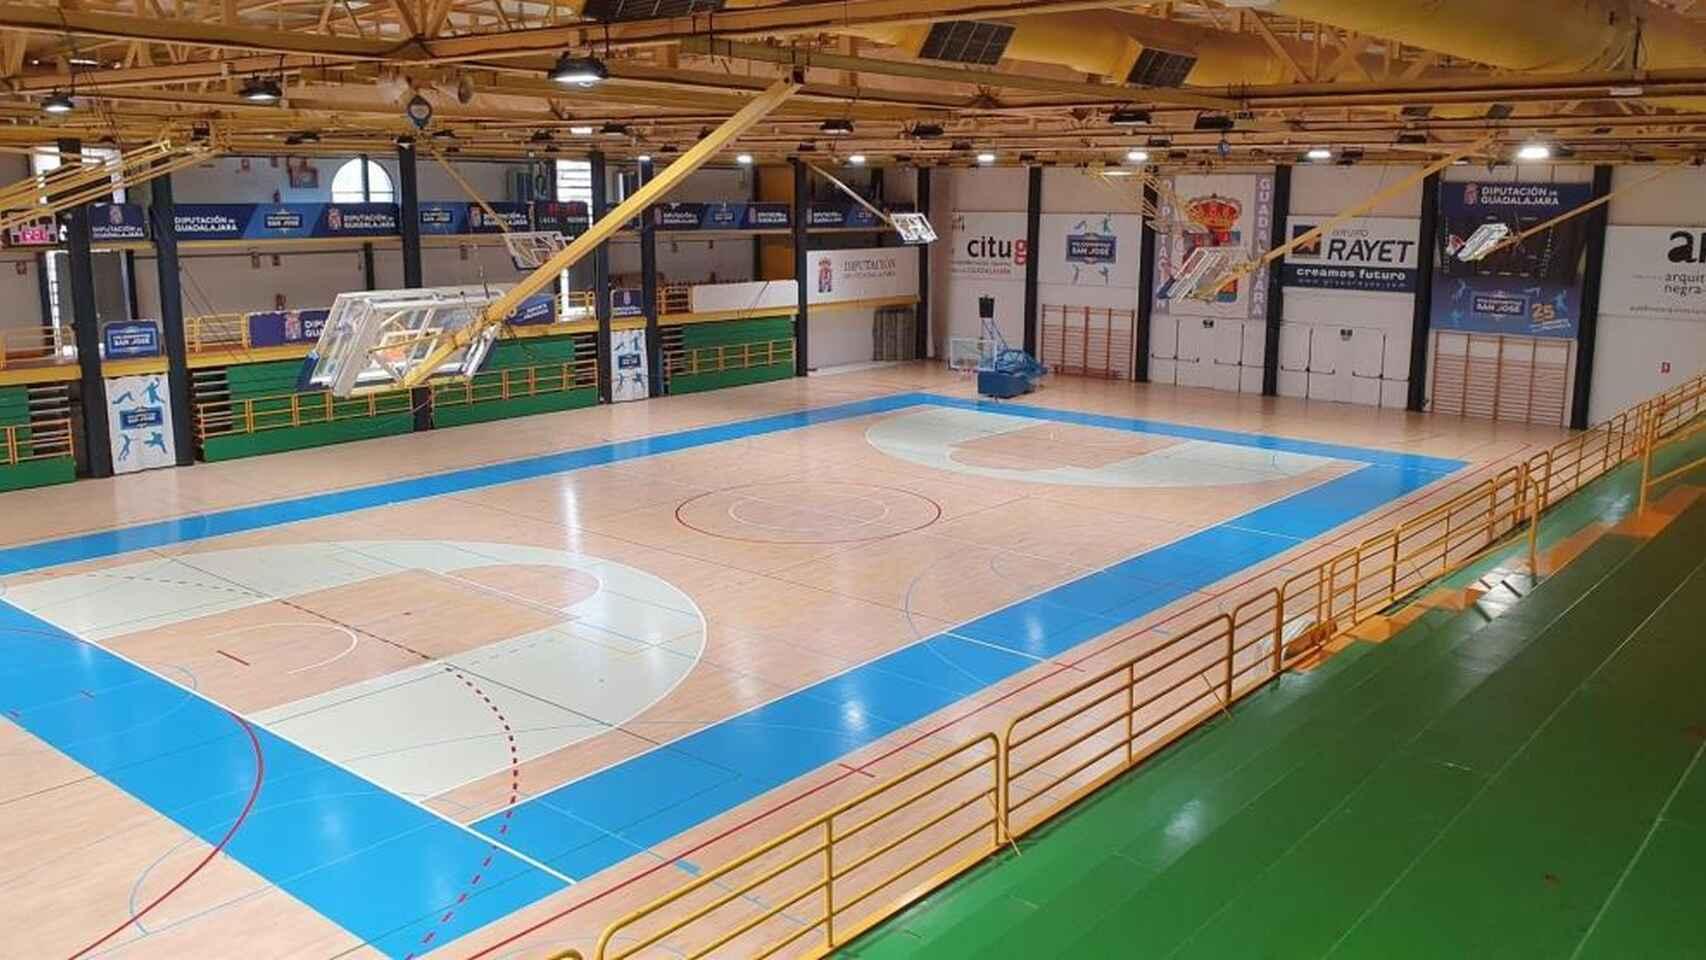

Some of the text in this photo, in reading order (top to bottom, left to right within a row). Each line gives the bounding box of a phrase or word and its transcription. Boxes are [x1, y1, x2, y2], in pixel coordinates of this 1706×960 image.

[174, 215, 227, 224] DIPUTACIÓN
[174, 223, 238, 232] GUADALAJARA
[967, 235, 1029, 266] citug
[1327, 239, 1415, 263] RAYET
[1296, 268, 1406, 281] creamos futuro
